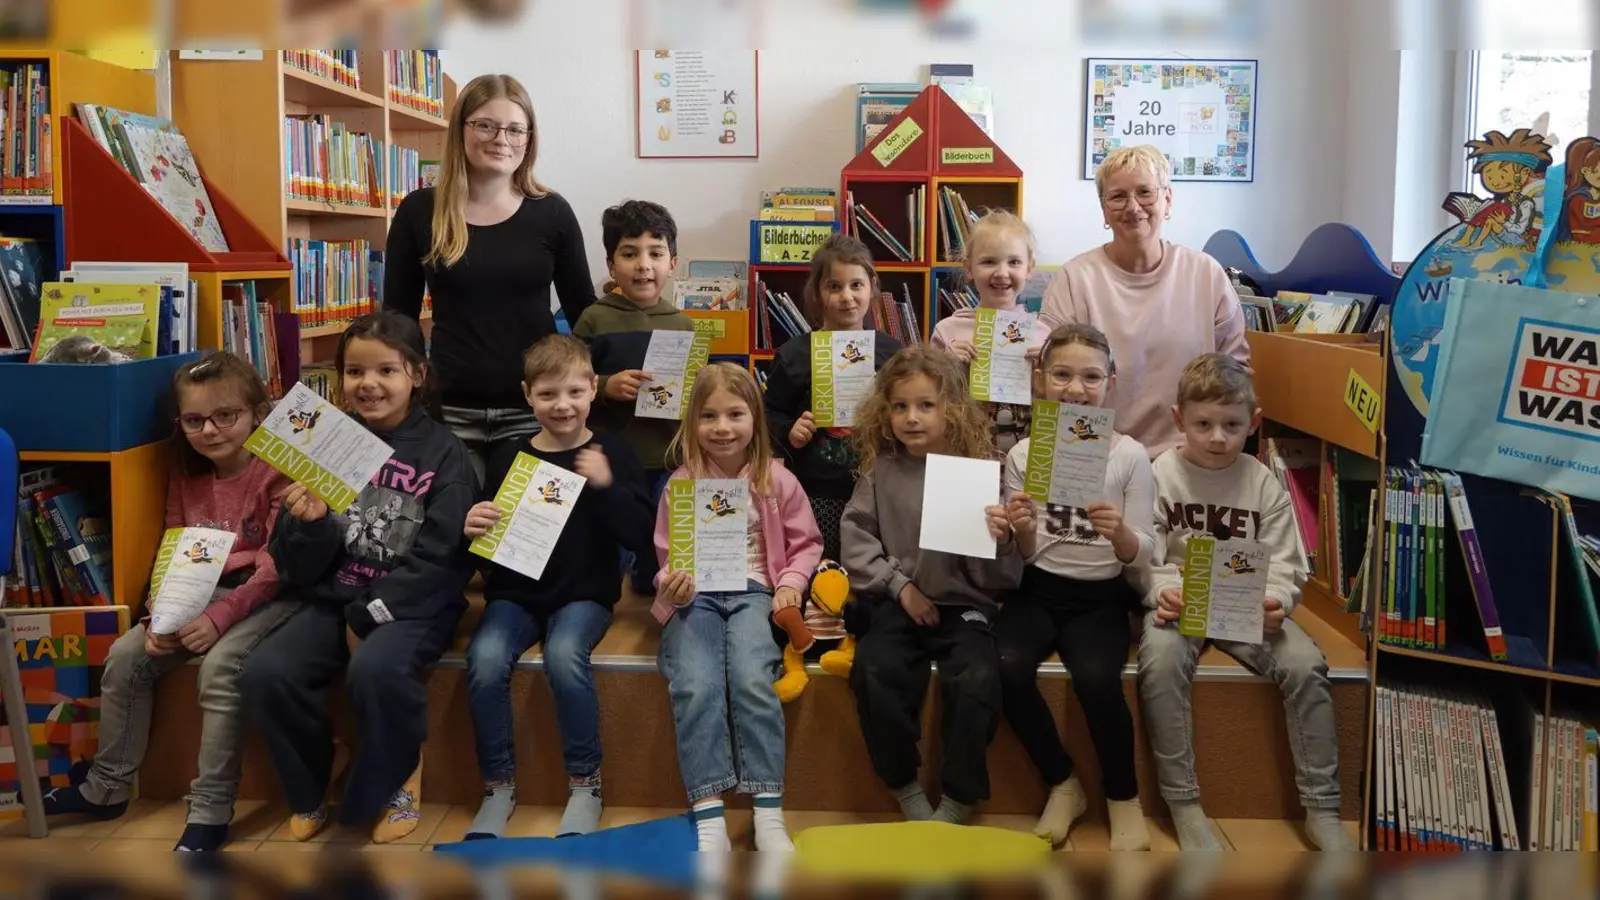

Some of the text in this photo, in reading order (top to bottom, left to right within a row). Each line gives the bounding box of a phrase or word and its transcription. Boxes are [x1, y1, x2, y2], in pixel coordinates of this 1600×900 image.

[1122, 119, 1176, 136] Jahre
[1139, 100, 1161, 116] 20
[885, 132, 901, 147] Das
[944, 151, 991, 161] Bilderbuch
[782, 250, 790, 260] A
[801, 250, 810, 260] Z
[972, 312, 996, 397] URKUNDE
[814, 335, 833, 423] URKUNDE
[1542, 364, 1600, 398] IST
[1348, 377, 1377, 423] NEU
[252, 429, 351, 506] URKUNDE
[1028, 405, 1059, 497] URKUNDE
[1497, 445, 1542, 463] Wissen
[1544, 454, 1565, 468] für
[476, 457, 537, 553] URKUNDE
[1184, 543, 1213, 631] URKUNDE
